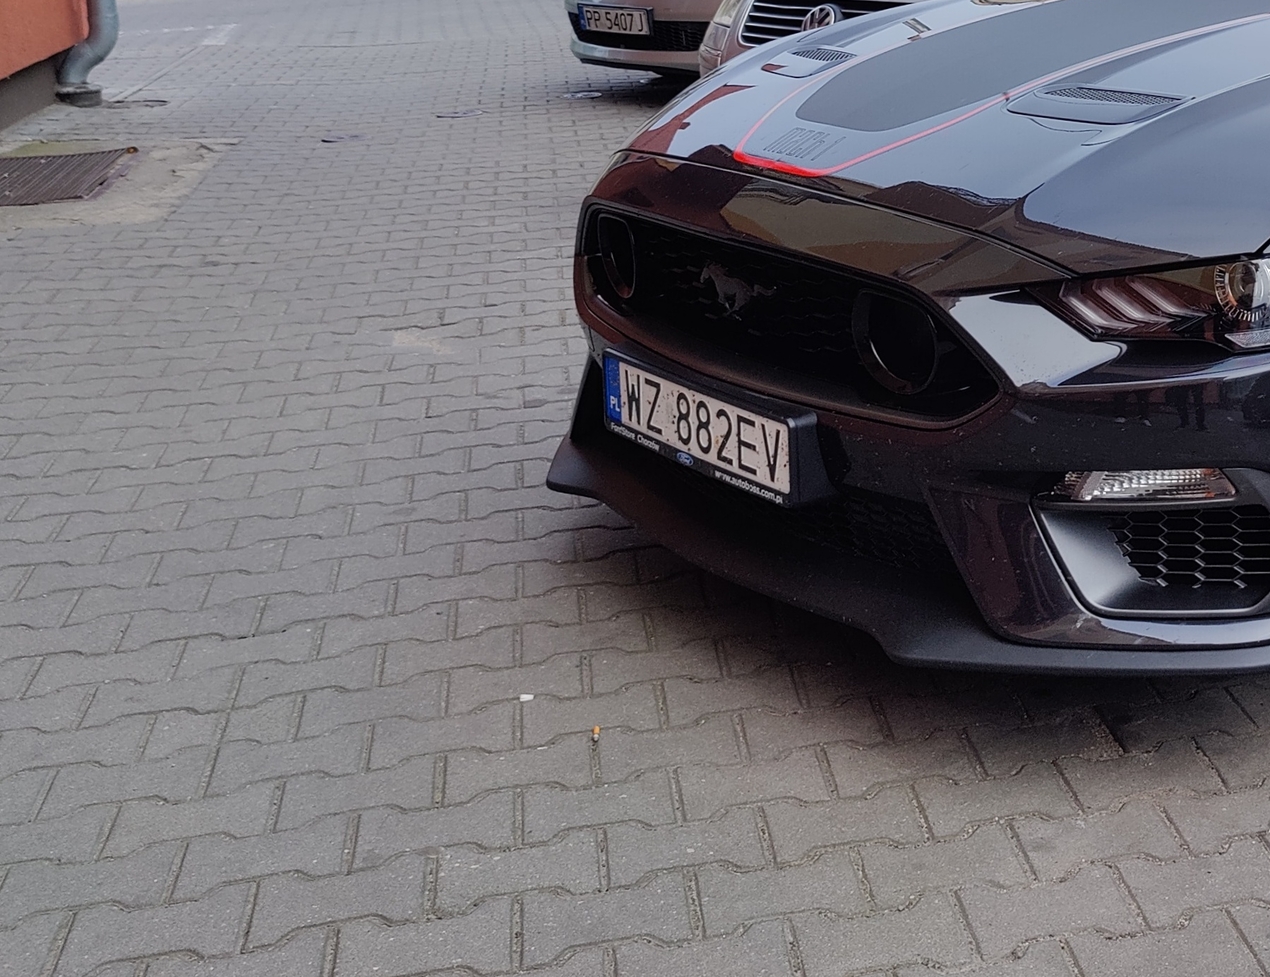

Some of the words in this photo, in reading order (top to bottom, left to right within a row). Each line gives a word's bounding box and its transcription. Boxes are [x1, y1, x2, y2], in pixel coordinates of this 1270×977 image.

[585, 9, 601, 29] PP
[605, 11, 634, 31] 5407
[638, 13, 644, 32] J
[610, 395, 621, 412] PL
[625, 369, 664, 436] WZ
[676, 392, 781, 483] 882EV
[714, 470, 783, 504] www.autoboss.com.pl
